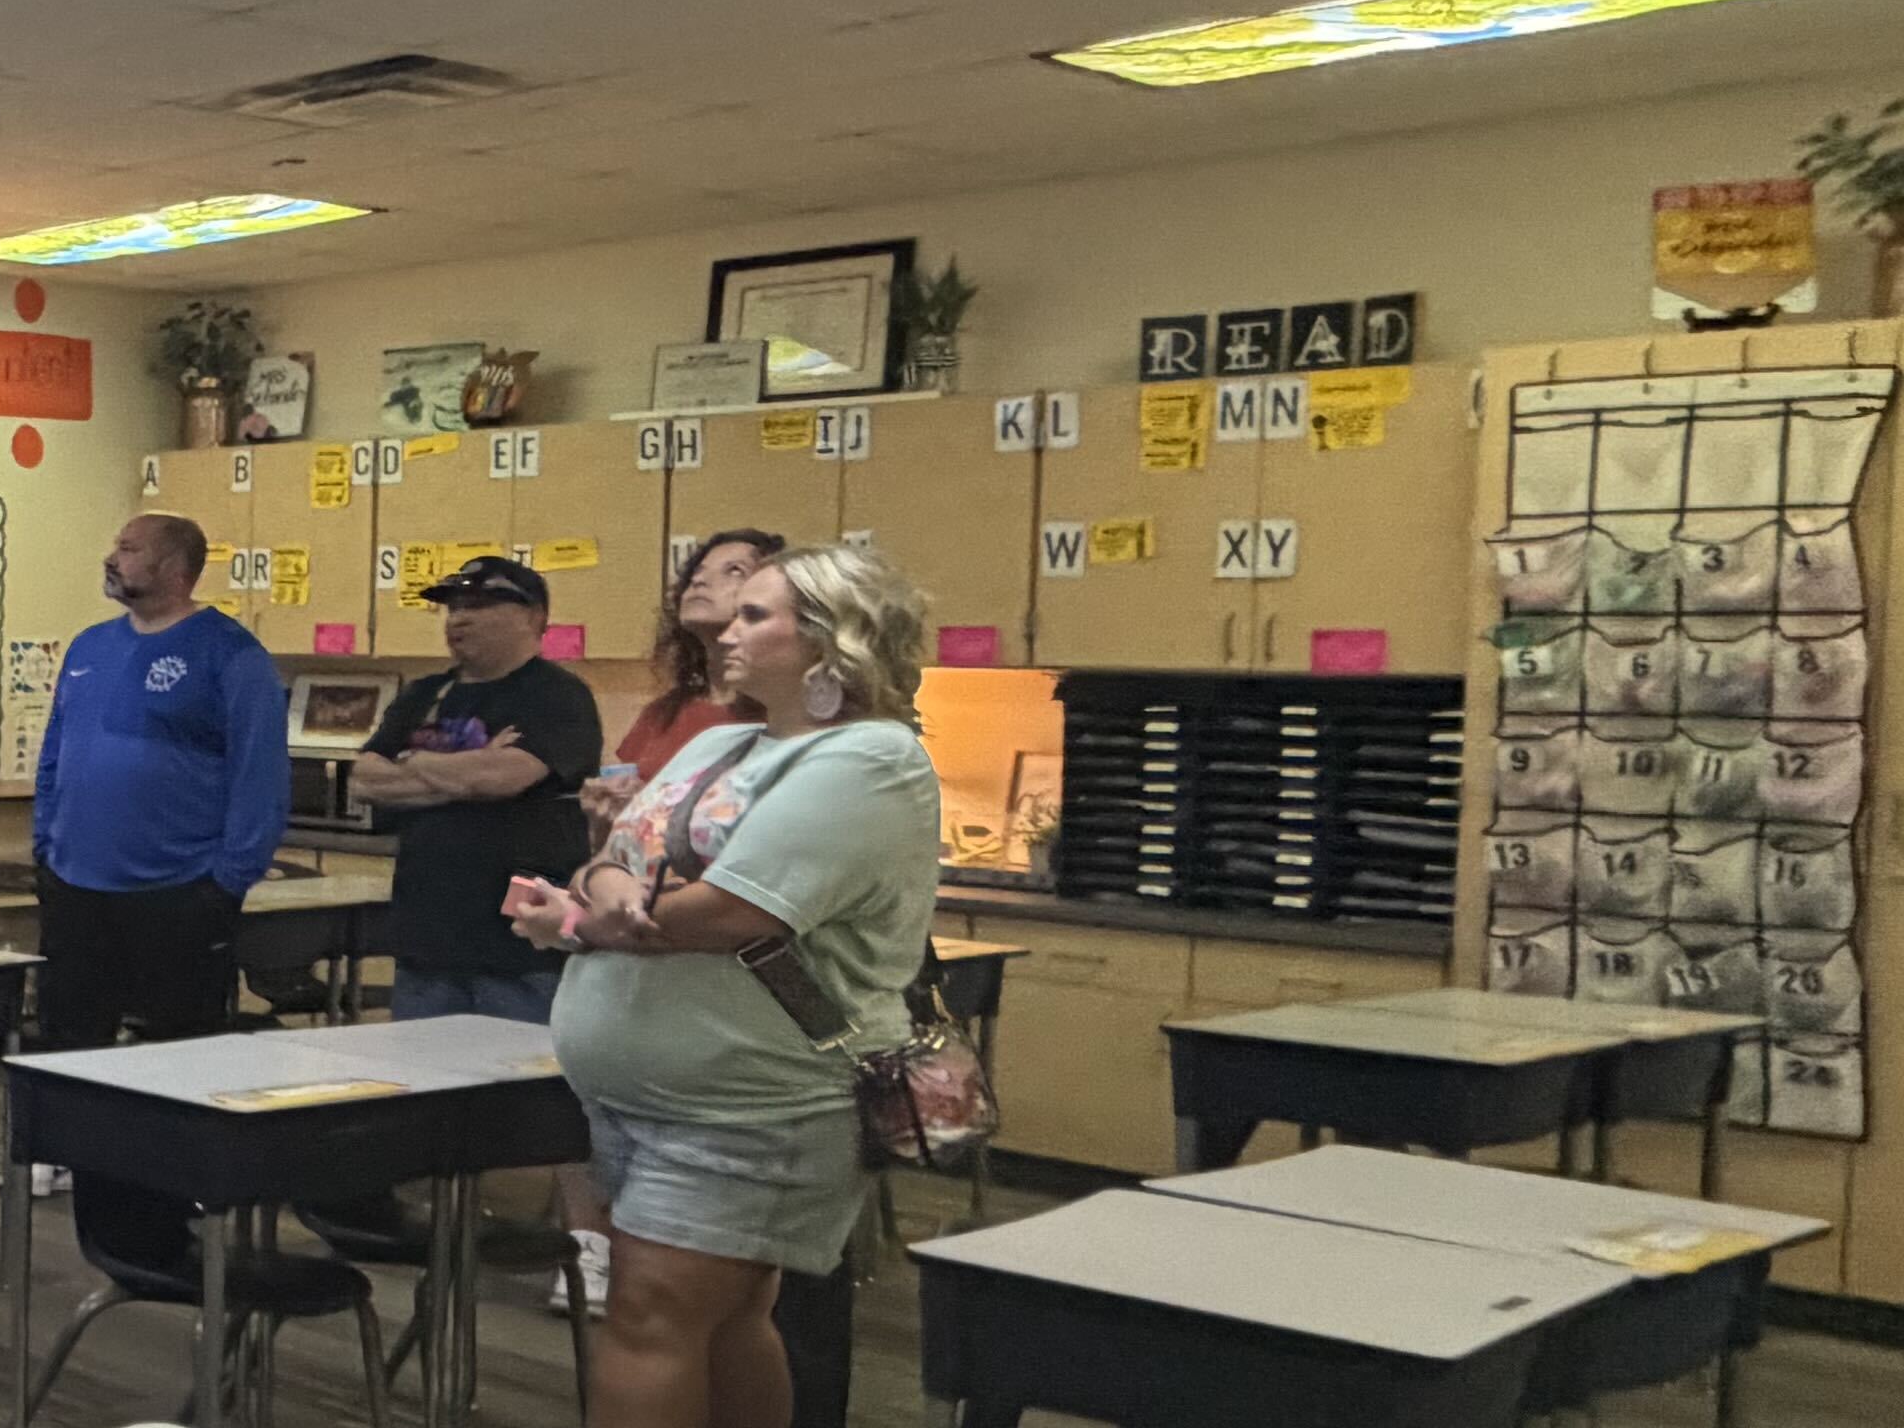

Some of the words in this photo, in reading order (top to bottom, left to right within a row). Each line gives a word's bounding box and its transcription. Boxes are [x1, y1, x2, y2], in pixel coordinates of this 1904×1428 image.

[1147, 307, 1410, 375] READ
[1001, 402, 1024, 440] K
[1053, 400, 1069, 437] L
[1220, 388, 1254, 430] M
[1271, 386, 1299, 427] N
[640, 427, 660, 460] G
[678, 429, 697, 462] H
[816, 416, 834, 453] I
[848, 414, 863, 451] J
[355, 448, 369, 476] C
[384, 445, 400, 475] D
[494, 441, 508, 470] E
[521, 438, 535, 468] F
[144, 461, 157, 487] A
[235, 456, 249, 483] B
[1044, 530, 1083, 570] W
[1221, 528, 1248, 570] X
[1265, 528, 1292, 568] Y
[1514, 550, 1527, 573] 1
[1703, 547, 1723, 572] 3
[1794, 545, 1811, 569] 4
[232, 553, 246, 586] Q
[254, 553, 268, 580] R
[381, 550, 396, 581] S
[1517, 651, 1537, 675] 5
[1632, 654, 1649, 677] 6
[1697, 649, 1713, 675] 7
[1799, 648, 1820, 673] 8
[1510, 749, 1530, 772] 9
[1616, 750, 1655, 775] 10
[1699, 753, 1724, 782] 11
[1773, 751, 1812, 779] 12
[1493, 842, 1531, 870] 13
[1602, 851, 1636, 876] 14
[1771, 857, 1807, 889] 16
[1498, 943, 1532, 969] 17
[1594, 951, 1633, 975] 18
[1677, 966, 1715, 996] 19
[1779, 966, 1824, 995] 20
